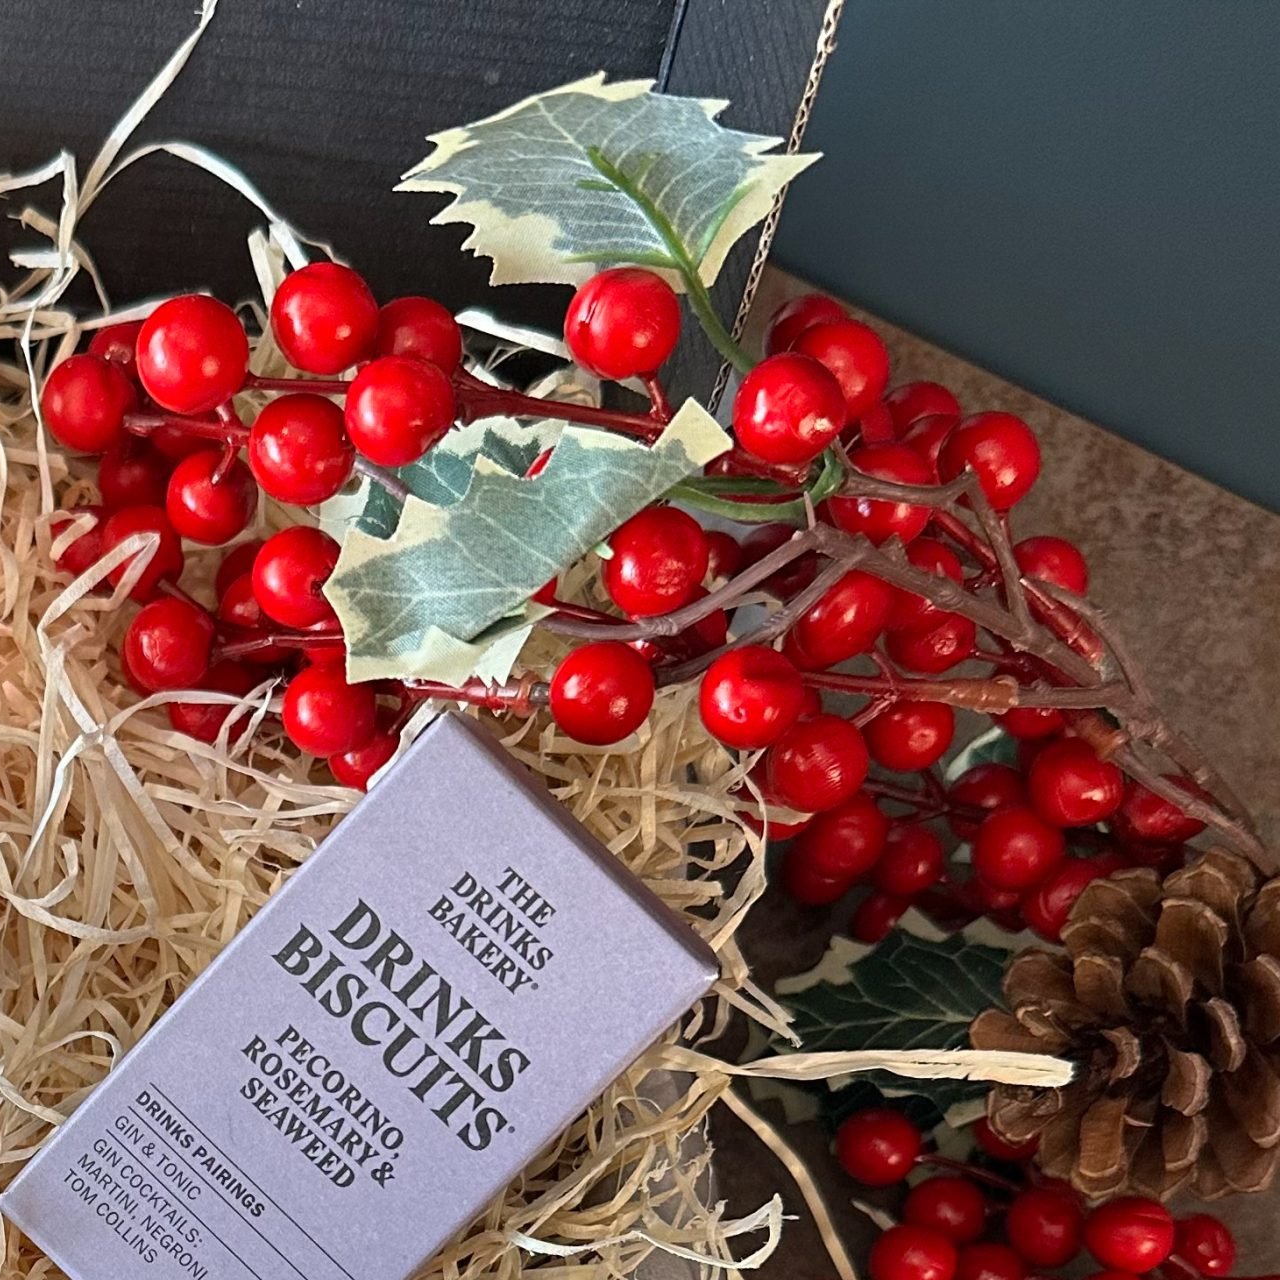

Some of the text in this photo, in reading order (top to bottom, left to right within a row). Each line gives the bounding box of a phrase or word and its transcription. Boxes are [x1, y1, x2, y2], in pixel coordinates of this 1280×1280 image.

[450, 871, 554, 970] DRINKS
[496, 866, 557, 928] THE
[271, 922, 508, 1151] BISCUITS
[328, 897, 531, 1092] DRINKS
[240, 1077, 355, 1188] SEAWEED
[241, 1035, 395, 1189] ROSEMARY &
[275, 1024, 404, 1159] PECORINO,
[77, 1154, 138, 1220] MARTINI,
[93, 1138, 204, 1249] GIN COCKTAILS:
[115, 1115, 202, 1200] GIN & TONIC
[135, 1090, 266, 1218] DRINKS PAIRINGS
[63, 1169, 158, 1264] TOM COLLINS
